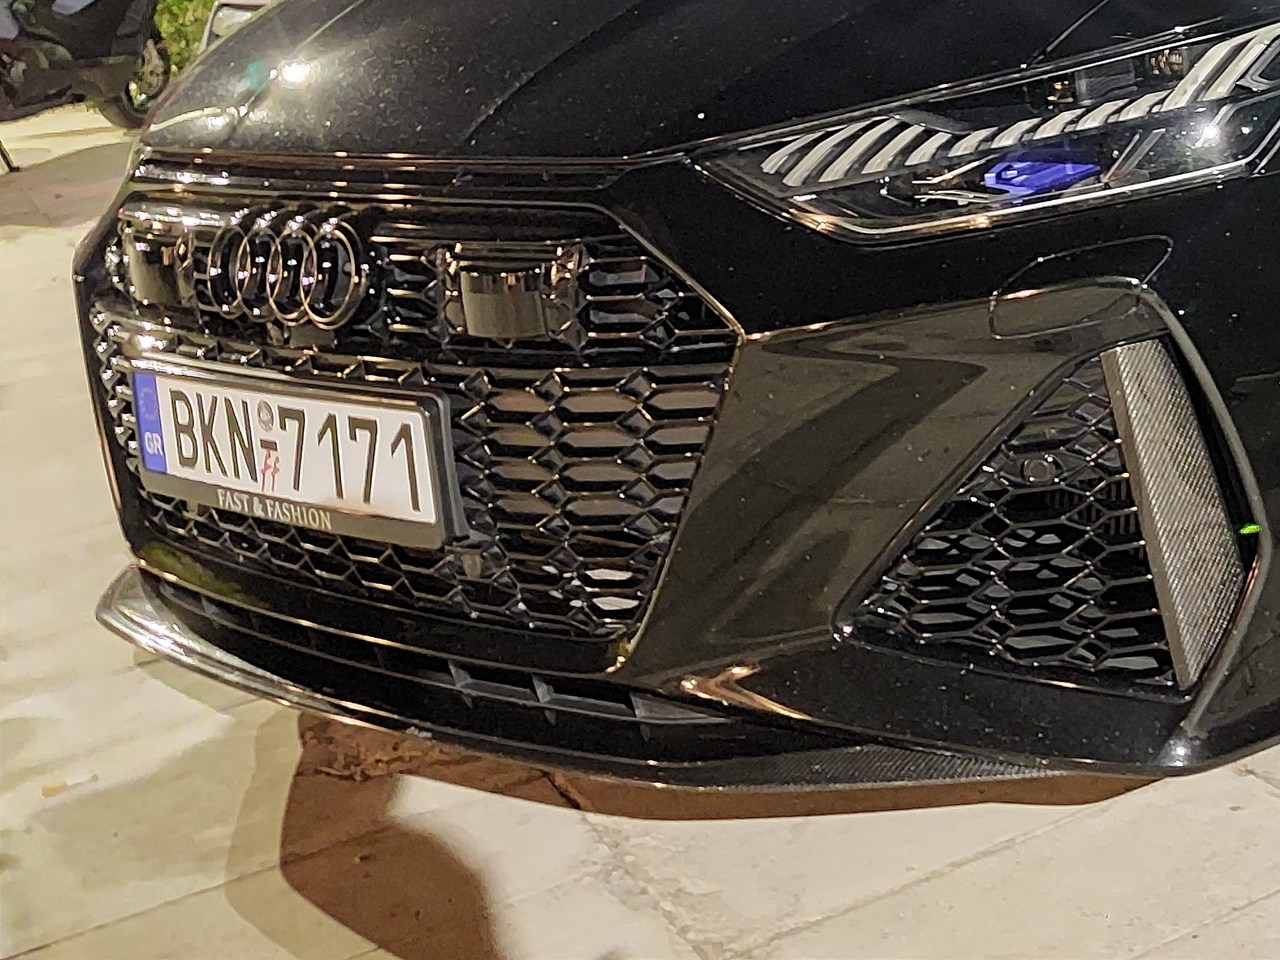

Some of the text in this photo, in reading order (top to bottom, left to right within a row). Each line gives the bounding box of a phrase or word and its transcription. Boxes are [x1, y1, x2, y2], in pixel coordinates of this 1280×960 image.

[144, 431, 164, 456] GR
[217, 488, 332, 530] FAST & FASHION
